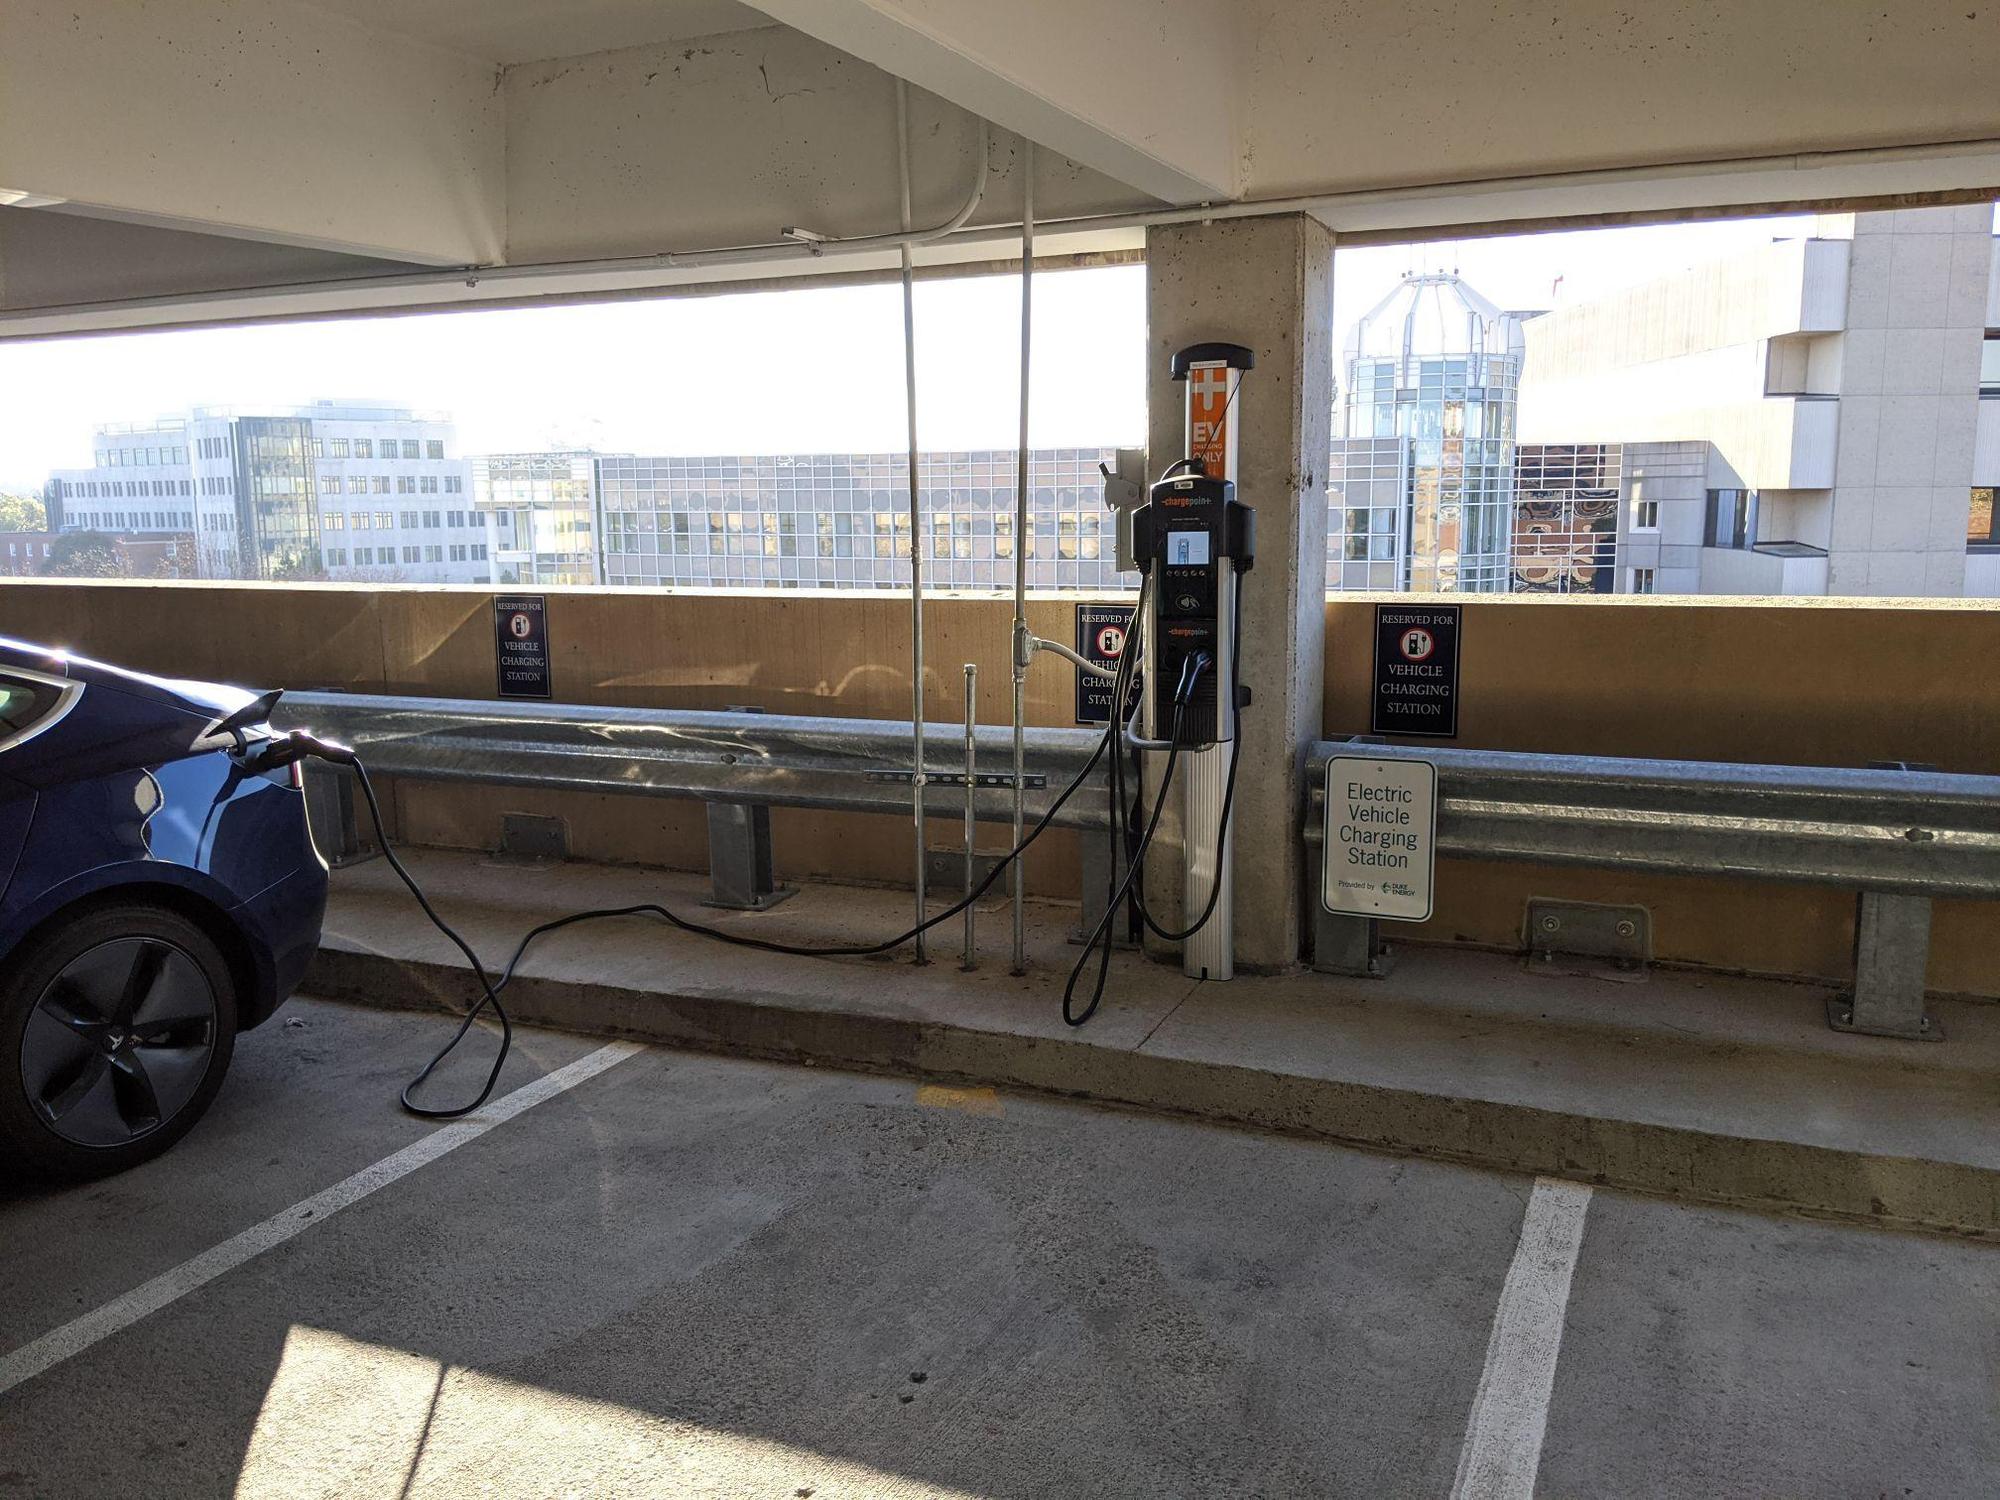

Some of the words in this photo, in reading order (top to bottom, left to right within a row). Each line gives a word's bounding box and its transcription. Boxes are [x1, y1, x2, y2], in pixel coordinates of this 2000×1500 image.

[1193, 421, 1224, 442] EV
[497, 602, 527, 610] RESERVED
[529, 603, 542, 611] FOR
[1081, 614, 1122, 623] RESERVED
[1382, 615, 1430, 625] RESERVED
[1433, 616, 1454, 625] FOR
[504, 641, 540, 651] VEHICLE
[501, 656, 544, 667] CHARGING
[506, 671, 540, 681] STATION
[1388, 664, 1443, 677] VEHICLE
[1380, 682, 1449, 696] CHARGING
[1387, 702, 1441, 715] STATION
[1347, 782, 1412, 803] Electric
[1348, 803, 1410, 825] Vehicle
[1340, 824, 1418, 851] Charging
[1347, 847, 1408, 868] Station
[1338, 880, 1365, 889] Provided
[1366, 880, 1375, 891] by
